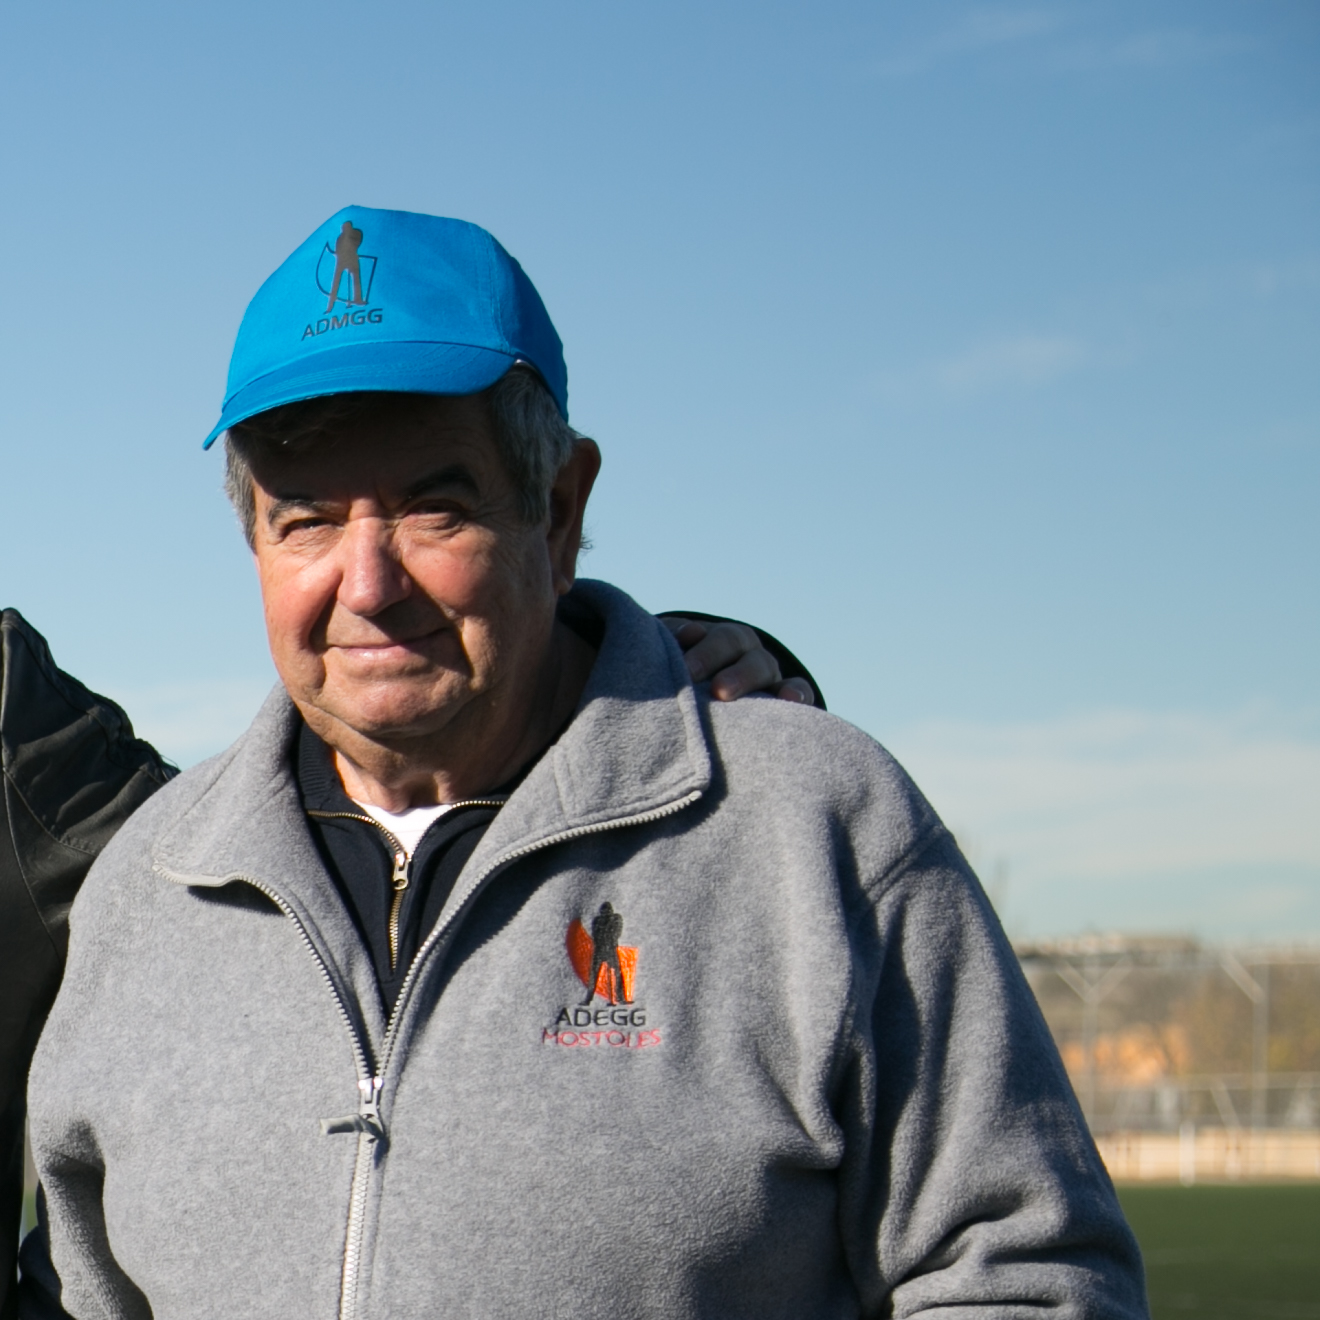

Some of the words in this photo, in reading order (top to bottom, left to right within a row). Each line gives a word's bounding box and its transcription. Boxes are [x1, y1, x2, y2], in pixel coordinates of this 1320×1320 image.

[301, 308, 383, 341] ADMGG
[556, 1007, 646, 1027] ADEGG
[542, 1027, 662, 1049] MOSTOLES
